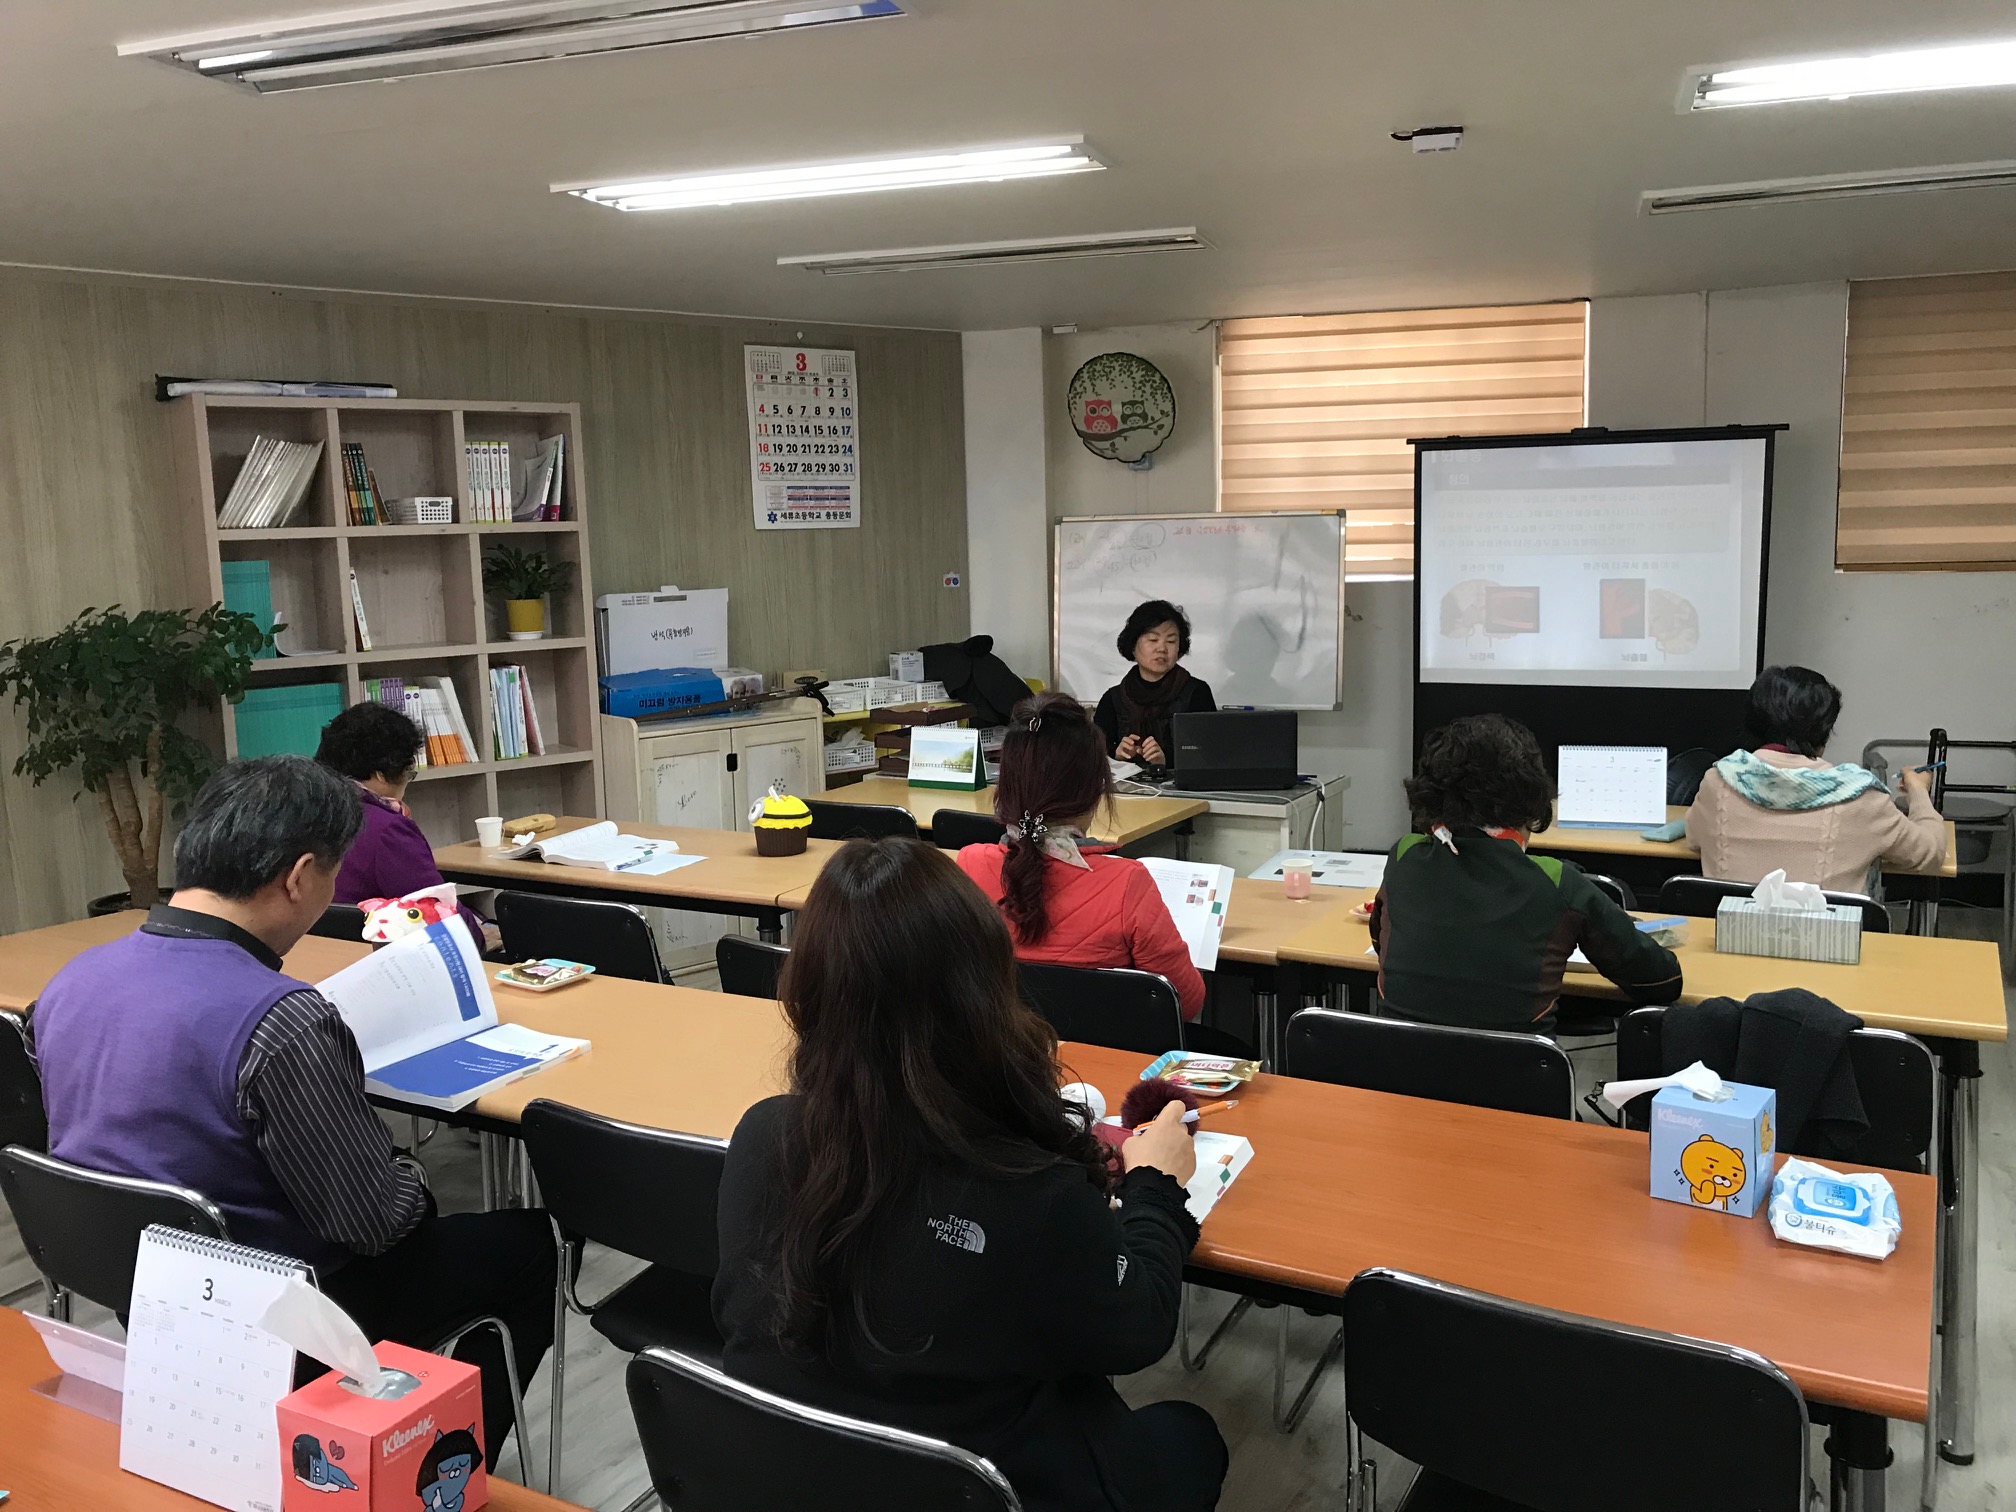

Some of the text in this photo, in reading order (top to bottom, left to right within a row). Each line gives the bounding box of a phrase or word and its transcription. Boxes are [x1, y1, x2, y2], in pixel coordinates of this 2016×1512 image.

[796, 353, 807, 372] 3
[828, 388, 834, 397] 2
[842, 388, 848, 397] 3
[759, 404, 850, 416] 4 5 6 7 8 9 10
[758, 424, 850, 435] 11 12 13 14 15 16 17
[759, 444, 852, 454] 18 19 20 21 22 23 24
[760, 462, 853, 473] 25 26 27 28 29 30 31
[1657, 1108, 1703, 1129] Kleenex
[927, 1218, 966, 1238] NORTH
[948, 1214, 969, 1229] THE
[1804, 1219, 1837, 1236] 물티슈
[936, 1230, 964, 1248] FACE
[202, 1278, 213, 1301] 3
[214, 1298, 231, 1307] MARCH
[216, 1387, 222, 1395] 15
[213, 1417, 219, 1425] 22
[234, 1424, 242, 1432] 23
[382, 1414, 434, 1457] Kleenex
